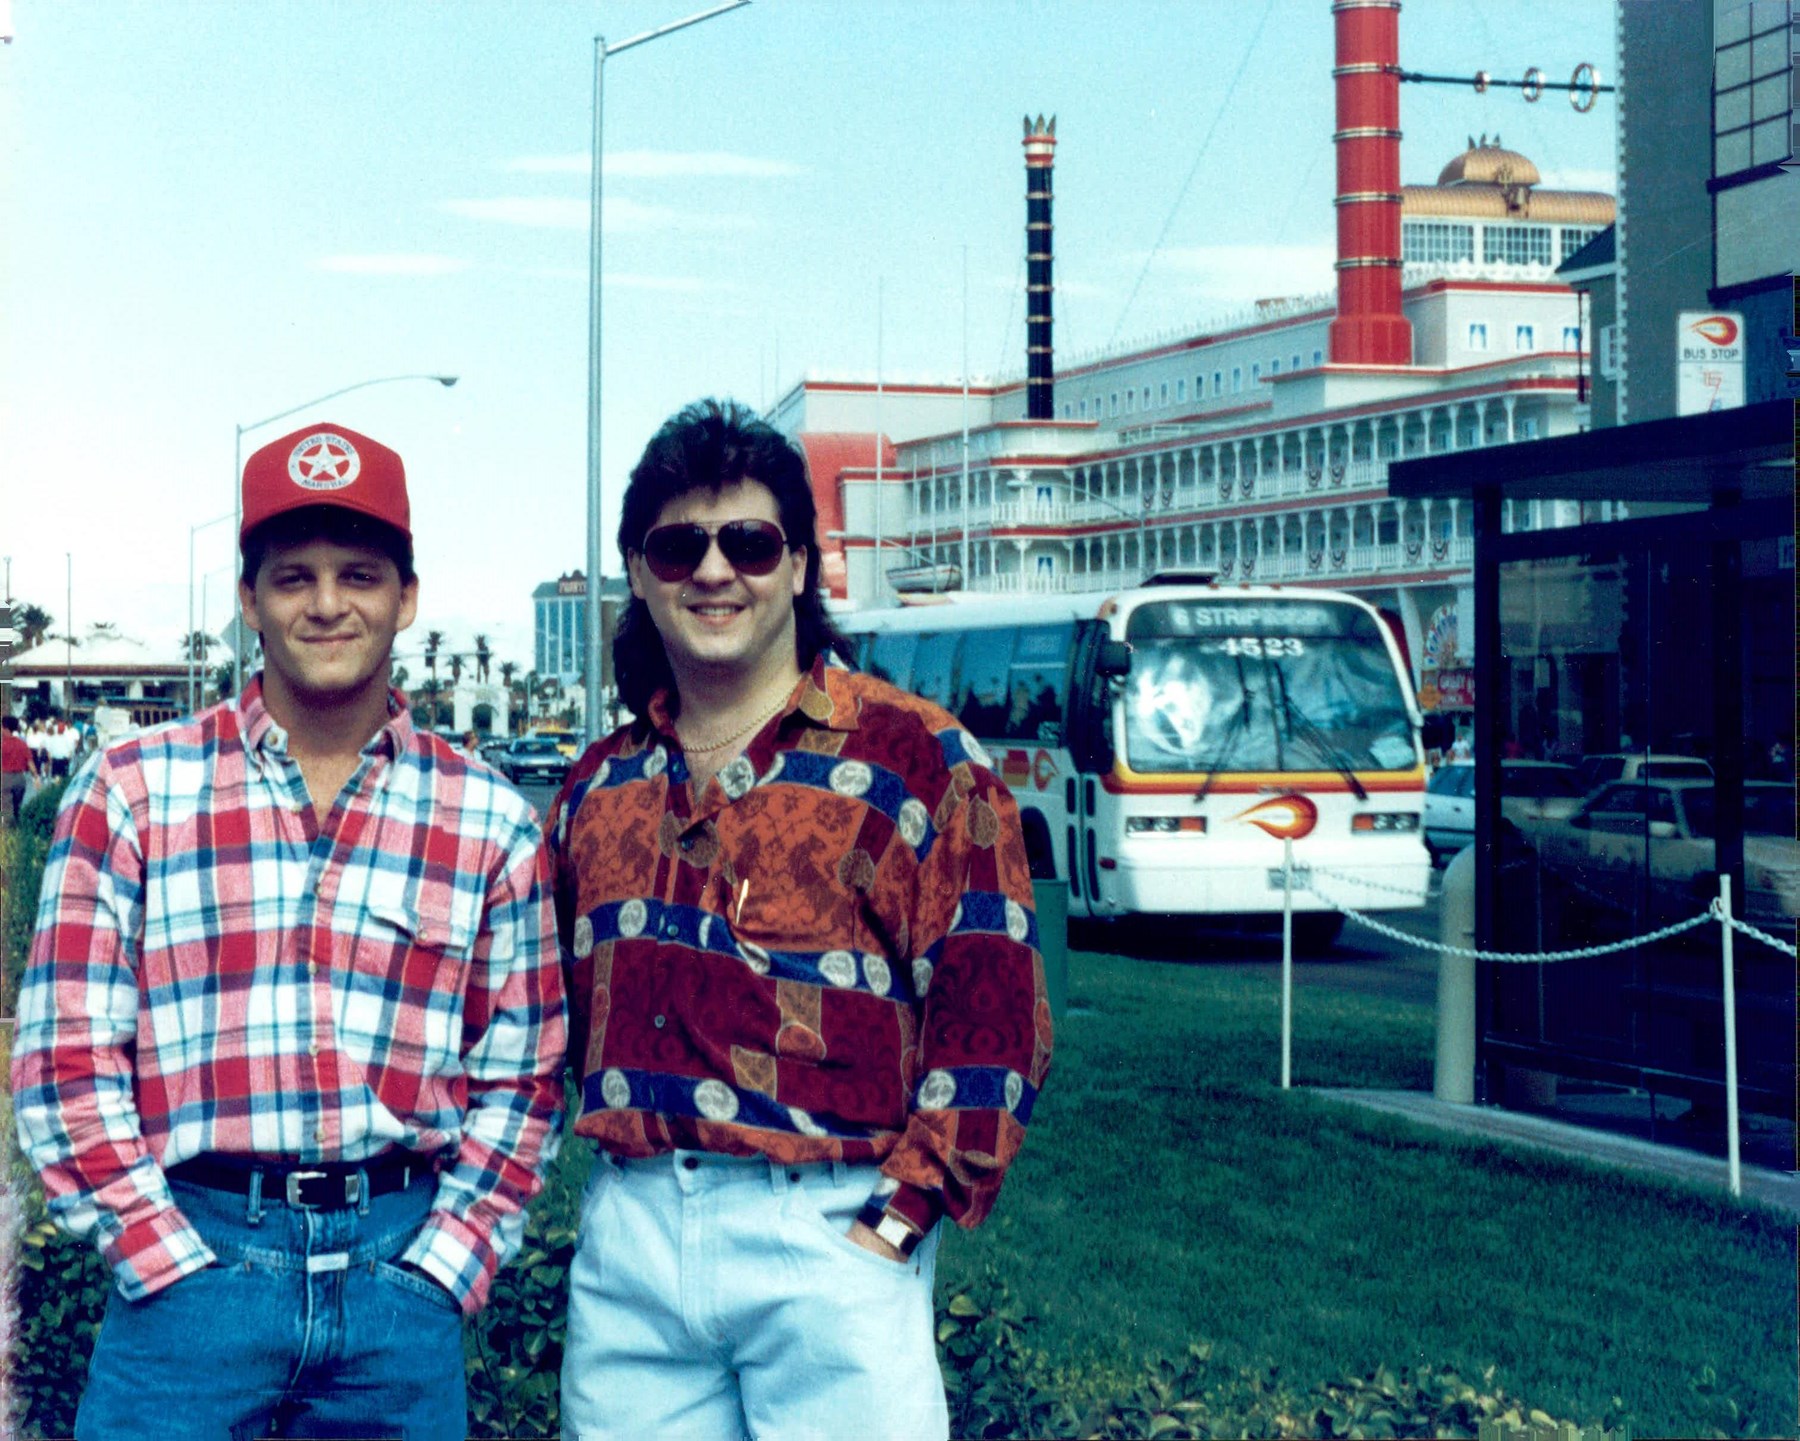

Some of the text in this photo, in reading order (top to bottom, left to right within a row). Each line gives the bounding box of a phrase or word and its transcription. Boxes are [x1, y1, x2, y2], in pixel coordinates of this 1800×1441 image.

[1683, 348, 1739, 360] BUS STOP
[1195, 608, 1260, 626] STRIP
[1219, 637, 1305, 659] 4523
